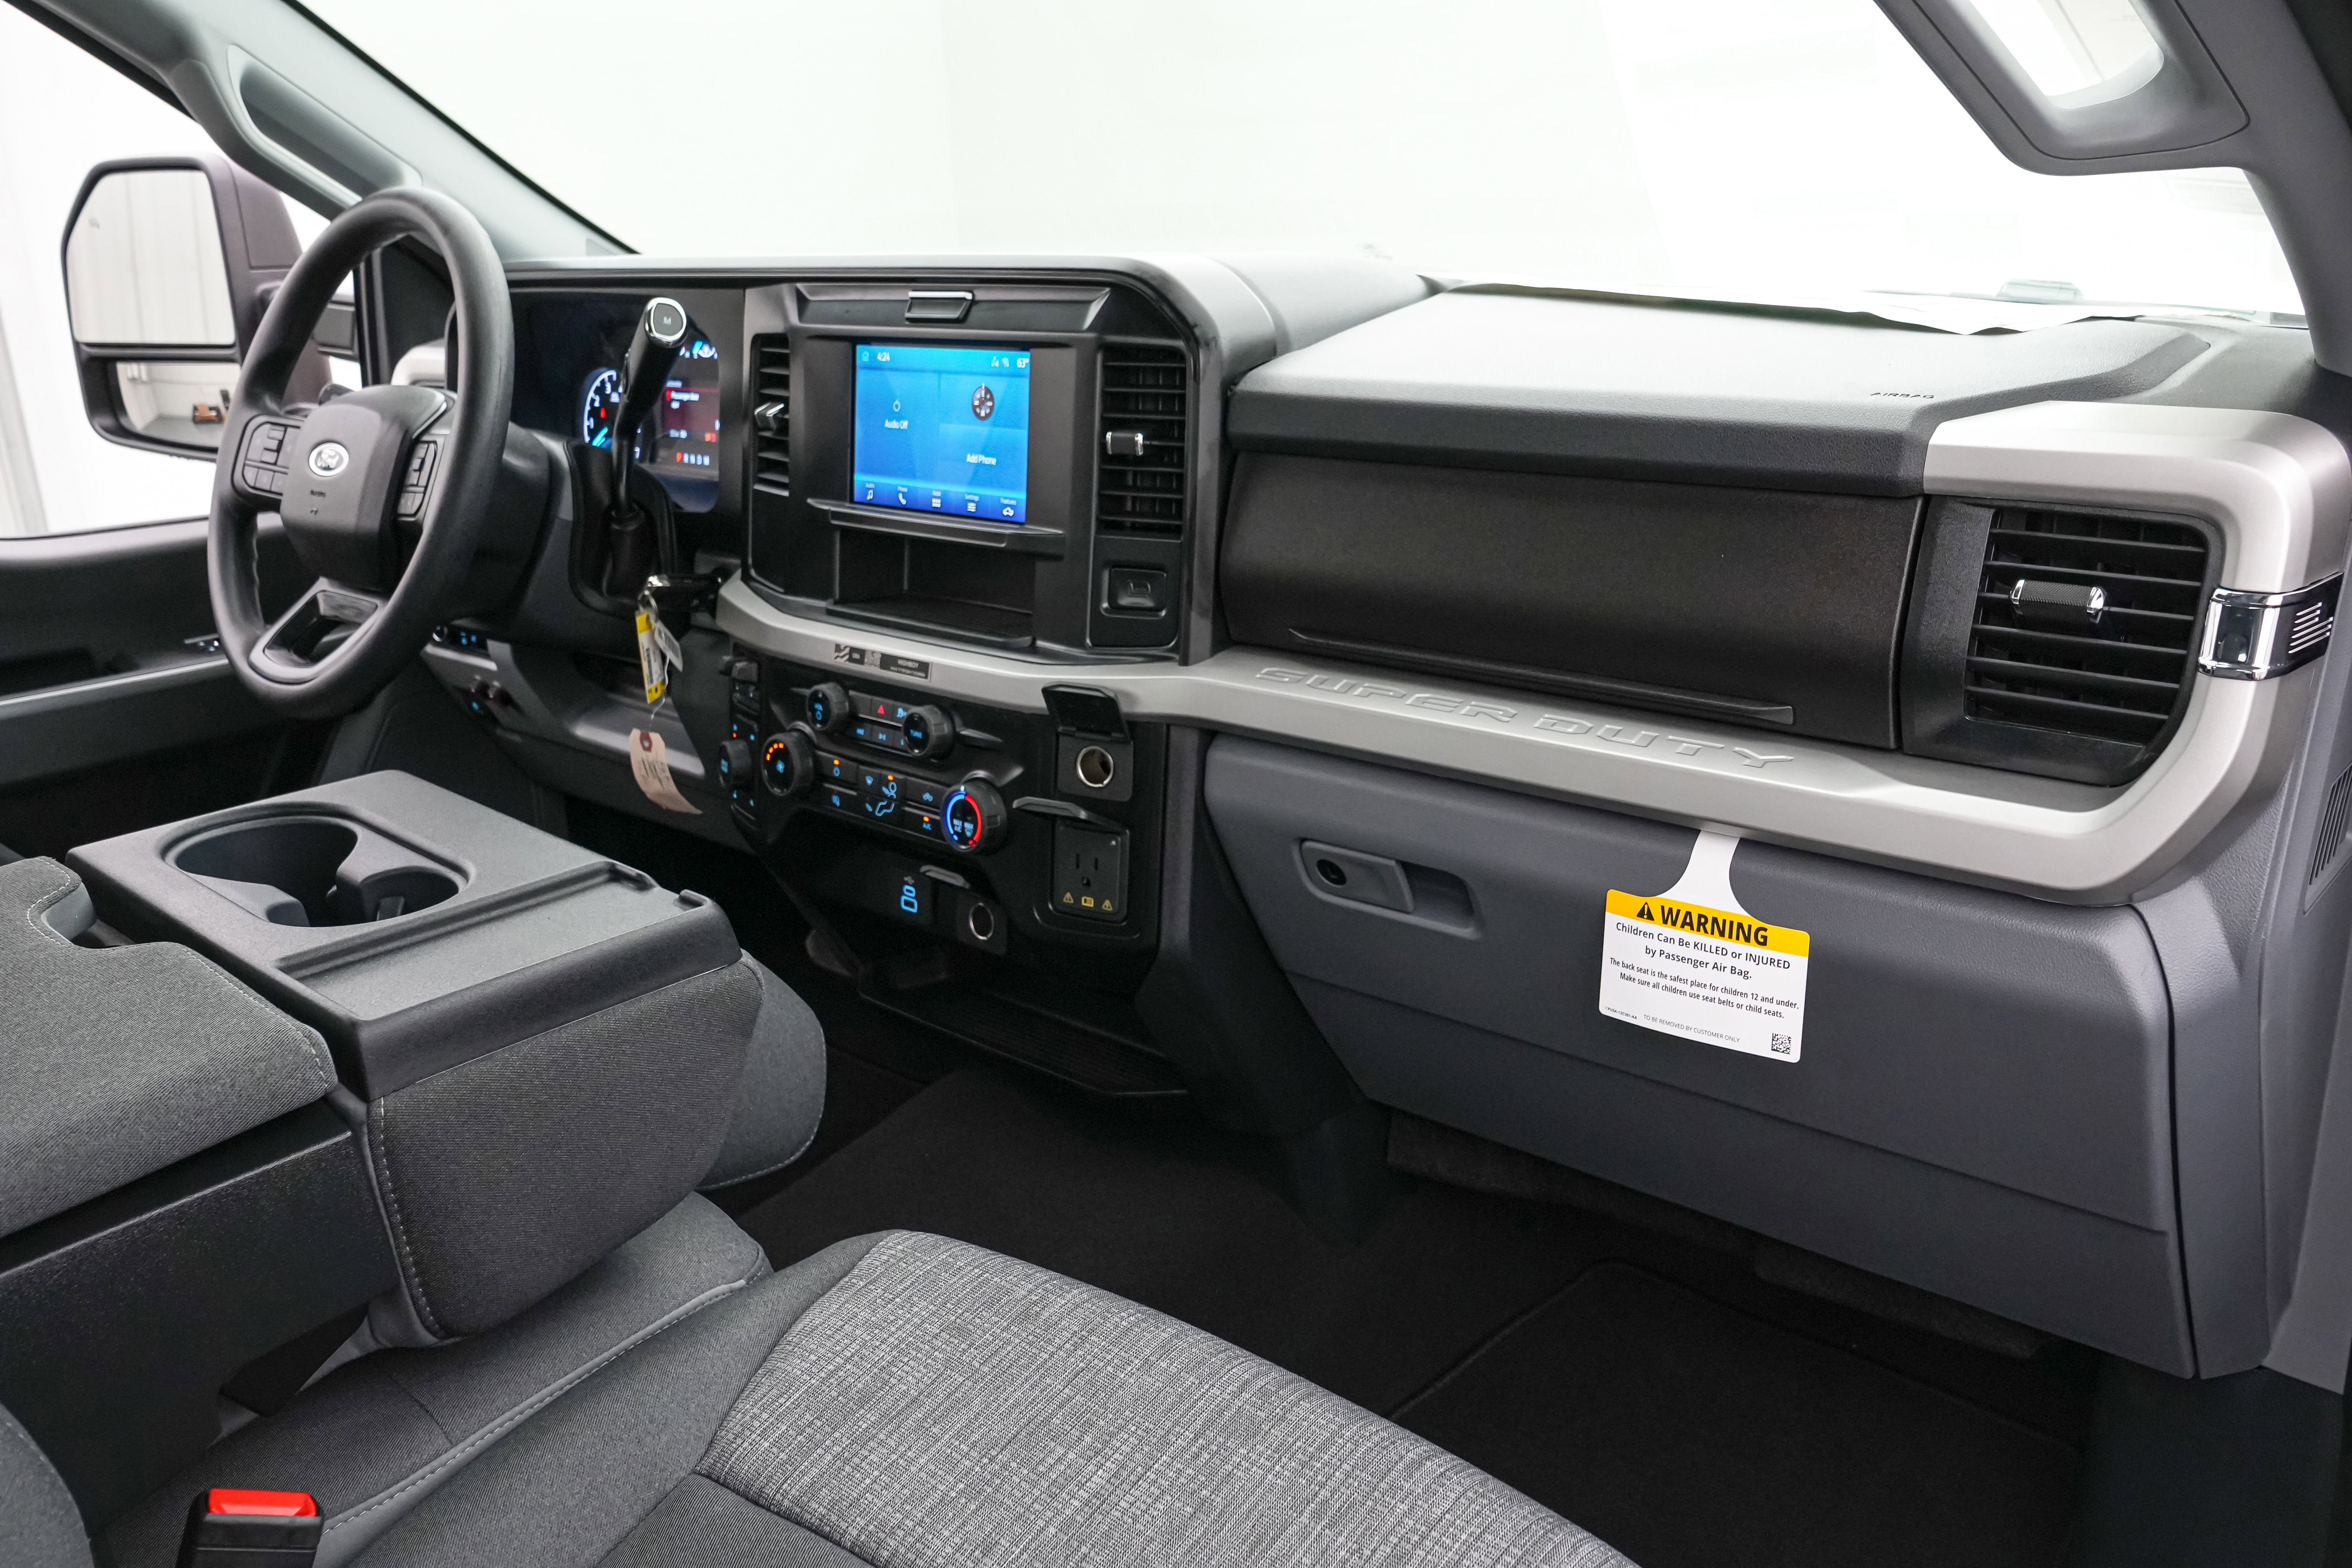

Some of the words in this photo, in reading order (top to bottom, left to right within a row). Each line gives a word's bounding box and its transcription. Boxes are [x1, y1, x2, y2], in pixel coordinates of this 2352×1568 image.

[885, 419, 900, 429] Audio
[900, 420, 908, 430] Off
[967, 454, 978, 463] Add
[979, 454, 996, 465] Phone
[1255, 667, 1518, 722] SUPER
[1533, 714, 1794, 768] DUTY
[1616, 922, 1654, 940] Children
[1657, 933, 1675, 944] Can
[1678, 938, 1690, 948] Be
[1694, 941, 1728, 956] KILLED
[1731, 951, 1742, 960] or
[1745, 953, 1790, 969] INJURED
[1661, 905, 1768, 947] WARNING
[1610, 957, 1620, 967] The
[1622, 960, 1635, 971] back
[1637, 967, 1649, 975] seat
[1651, 969, 1655, 977] is
[1658, 971, 1668, 980] the
[1670, 975, 1688, 985] safest
[1690, 979, 1707, 989] place
[1709, 983, 1719, 992] for
[1721, 986, 1748, 998] children
[1776, 1000, 1799, 1009] under.
[1645, 945, 1657, 958] by
[1659, 949, 1709, 969] Passenger
[1712, 962, 1727, 972] Air
[1731, 966, 1752, 980] Bag.
[1620, 972, 1636, 983] Make
[1637, 979, 1650, 987] sure
[1662, 984, 1687, 996] children
[1702, 995, 1716, 1004] seat
[1718, 997, 1734, 1007] belts
[1746, 1004, 1762, 1013] child
[1764, 1009, 1784, 1018] seats.
[1659, 1019, 1684, 1029] REMOVED
[1693, 1027, 1723, 1039] CUSTOMER
